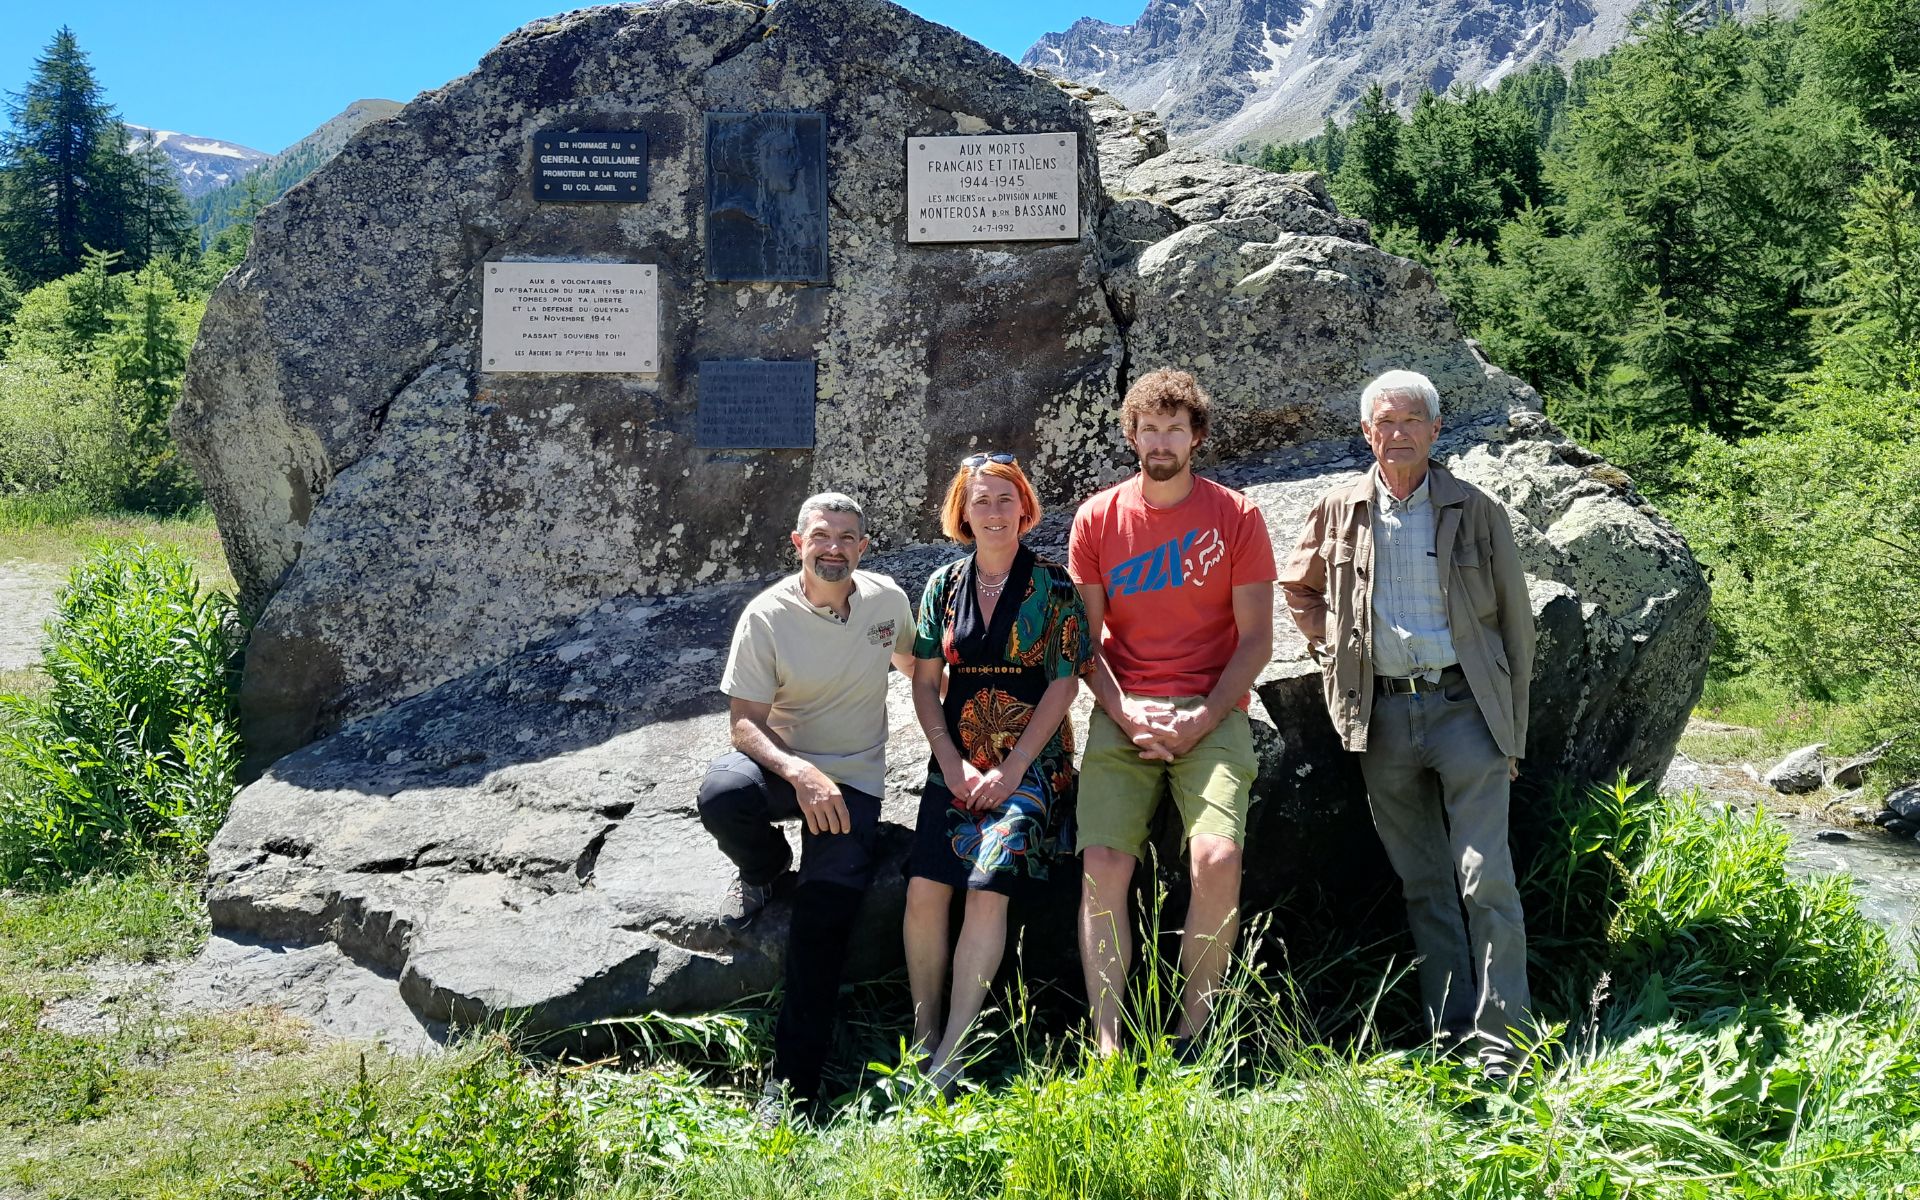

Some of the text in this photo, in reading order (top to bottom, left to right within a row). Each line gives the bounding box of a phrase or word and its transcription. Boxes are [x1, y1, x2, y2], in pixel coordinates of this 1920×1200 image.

[960, 143, 1025, 156] AUX MORTS
[540, 155, 640, 165] GENERAL A. GUILLAUME
[928, 155, 1057, 172] FRANCAIS ET ITALIENS
[960, 175, 1025, 188] 1944-1945
[928, 194, 942, 203] LES
[946, 194, 976, 202] ANCIENS
[999, 193, 1030, 201] DIVISION
[1033, 192, 1058, 200] ALPINE
[920, 207, 986, 219] MONTEROSA
[1015, 204, 1067, 217] BASSANO
[972, 224, 1014, 233] 24-7-1992
